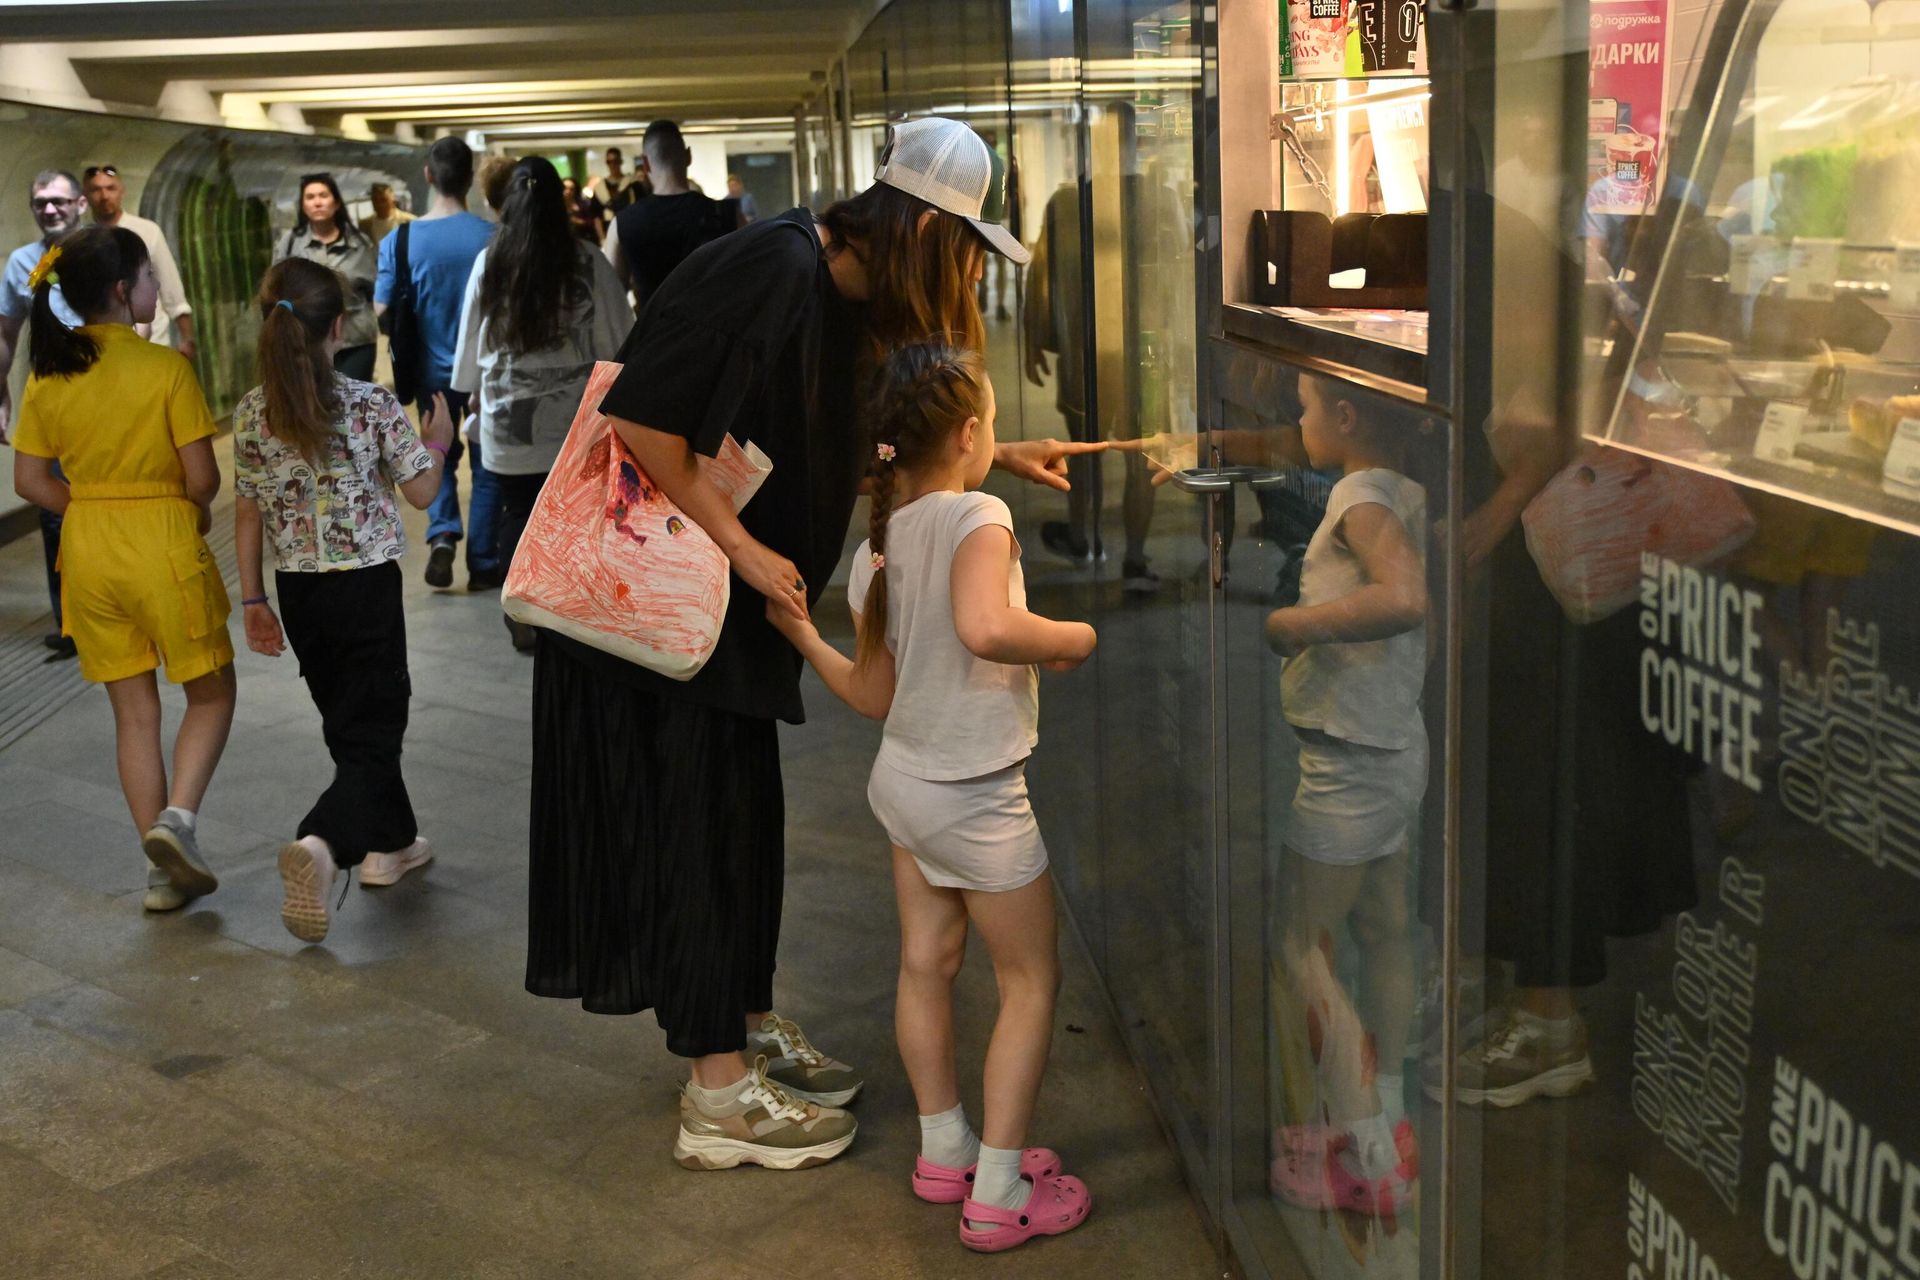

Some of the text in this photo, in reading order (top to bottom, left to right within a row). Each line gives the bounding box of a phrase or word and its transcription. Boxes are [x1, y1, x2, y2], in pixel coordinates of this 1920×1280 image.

[1313, 5, 1339, 16] COFFEE
[1590, 42, 1660, 69] ДАРКИ
[1604, 15, 1661, 30] подружка
[1617, 171, 1638, 179] COFFEE
[1639, 551, 1764, 690] ONE PRICE
[1640, 648, 1763, 793] COFFEE
[1778, 660, 1827, 825] ONE
[1824, 607, 1880, 860] MORE
[1631, 991, 1668, 1135] ONE
[1663, 911, 1715, 1169] WAY OR
[1627, 1172, 1646, 1258] ONE
[1763, 1160, 1908, 1280] COFF
[1769, 1055, 1920, 1276] ONE PRICE
